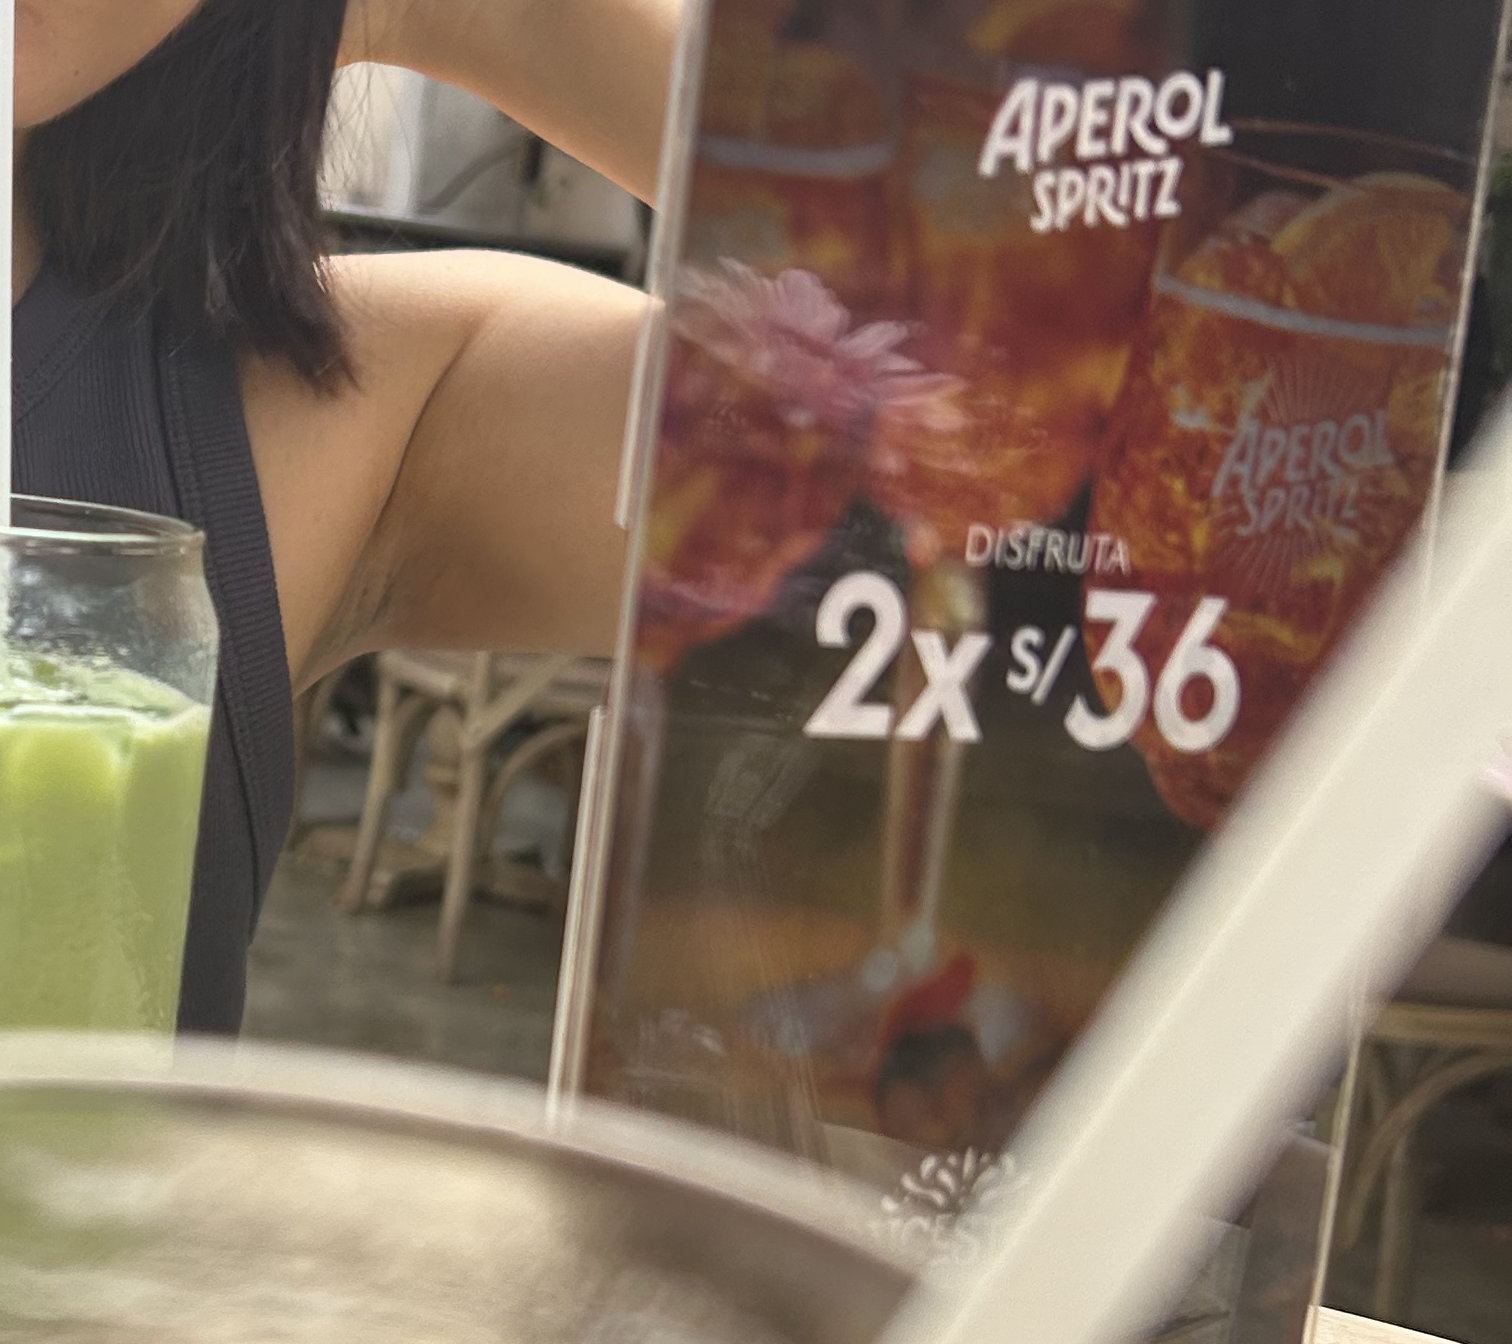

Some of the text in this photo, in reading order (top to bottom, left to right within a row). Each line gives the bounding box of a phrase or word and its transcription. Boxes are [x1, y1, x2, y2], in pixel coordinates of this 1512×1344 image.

[979, 68, 1233, 178] APEROL
[1030, 158, 1183, 233] SPRITZ
[1211, 410, 1394, 497] APEROL
[965, 524, 1131, 575] DISFRUTA
